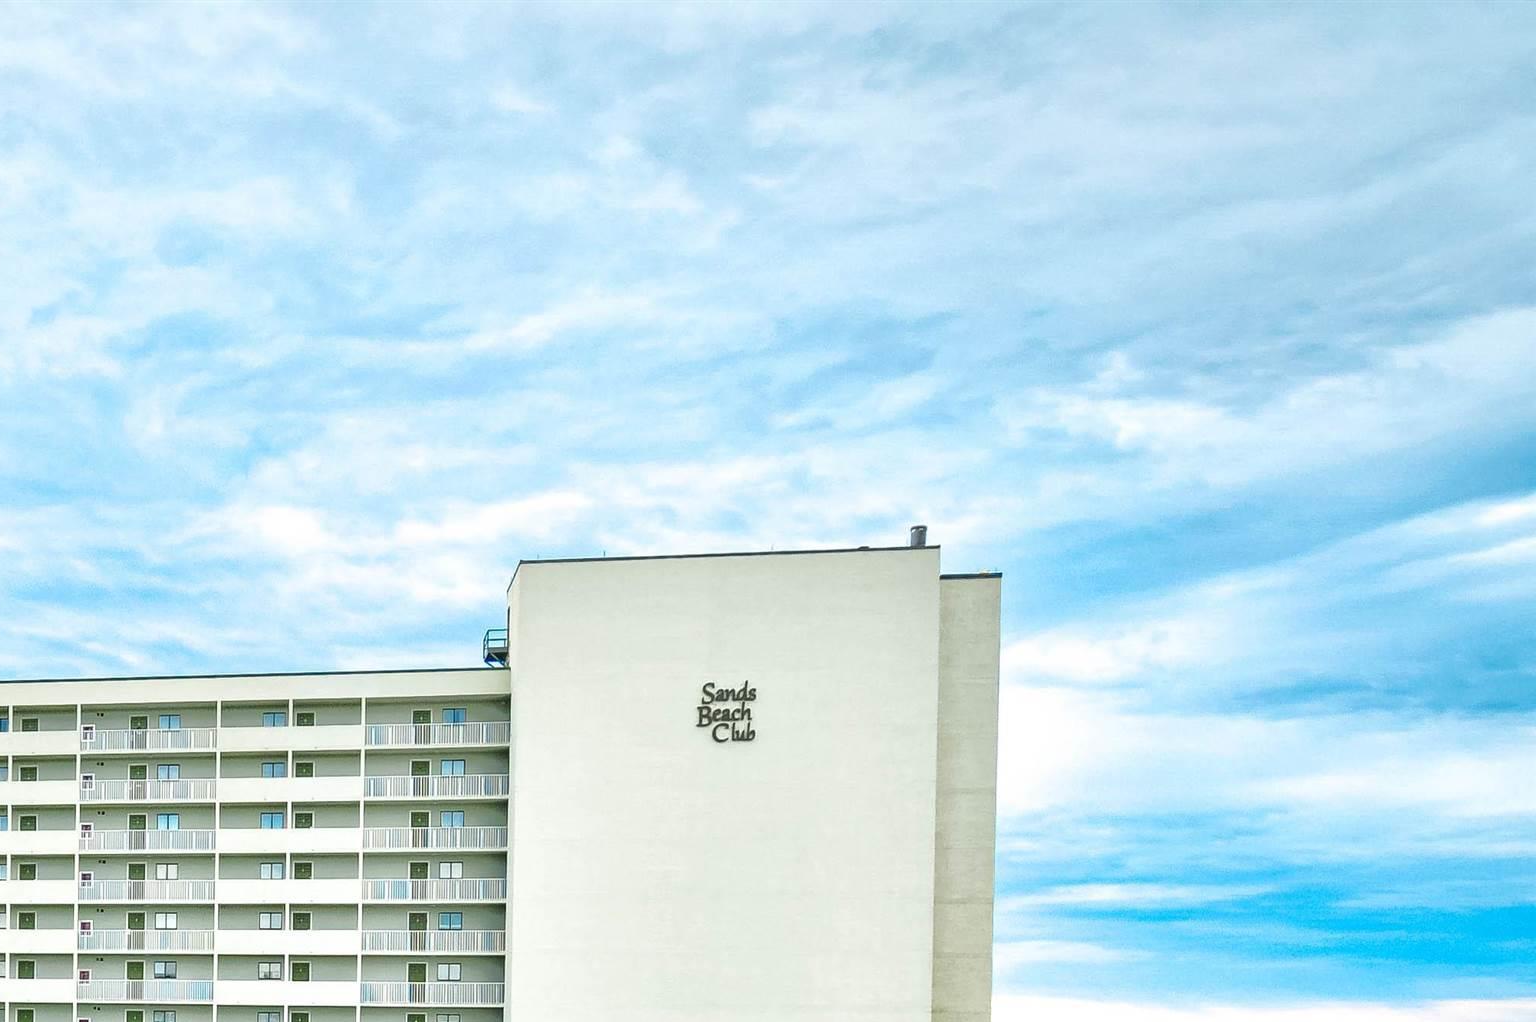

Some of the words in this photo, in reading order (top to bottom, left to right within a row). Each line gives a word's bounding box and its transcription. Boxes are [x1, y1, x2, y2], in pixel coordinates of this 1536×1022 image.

[701, 680, 757, 705] Sands
[696, 701, 752, 727] Beach
[712, 721, 756, 743] Club
